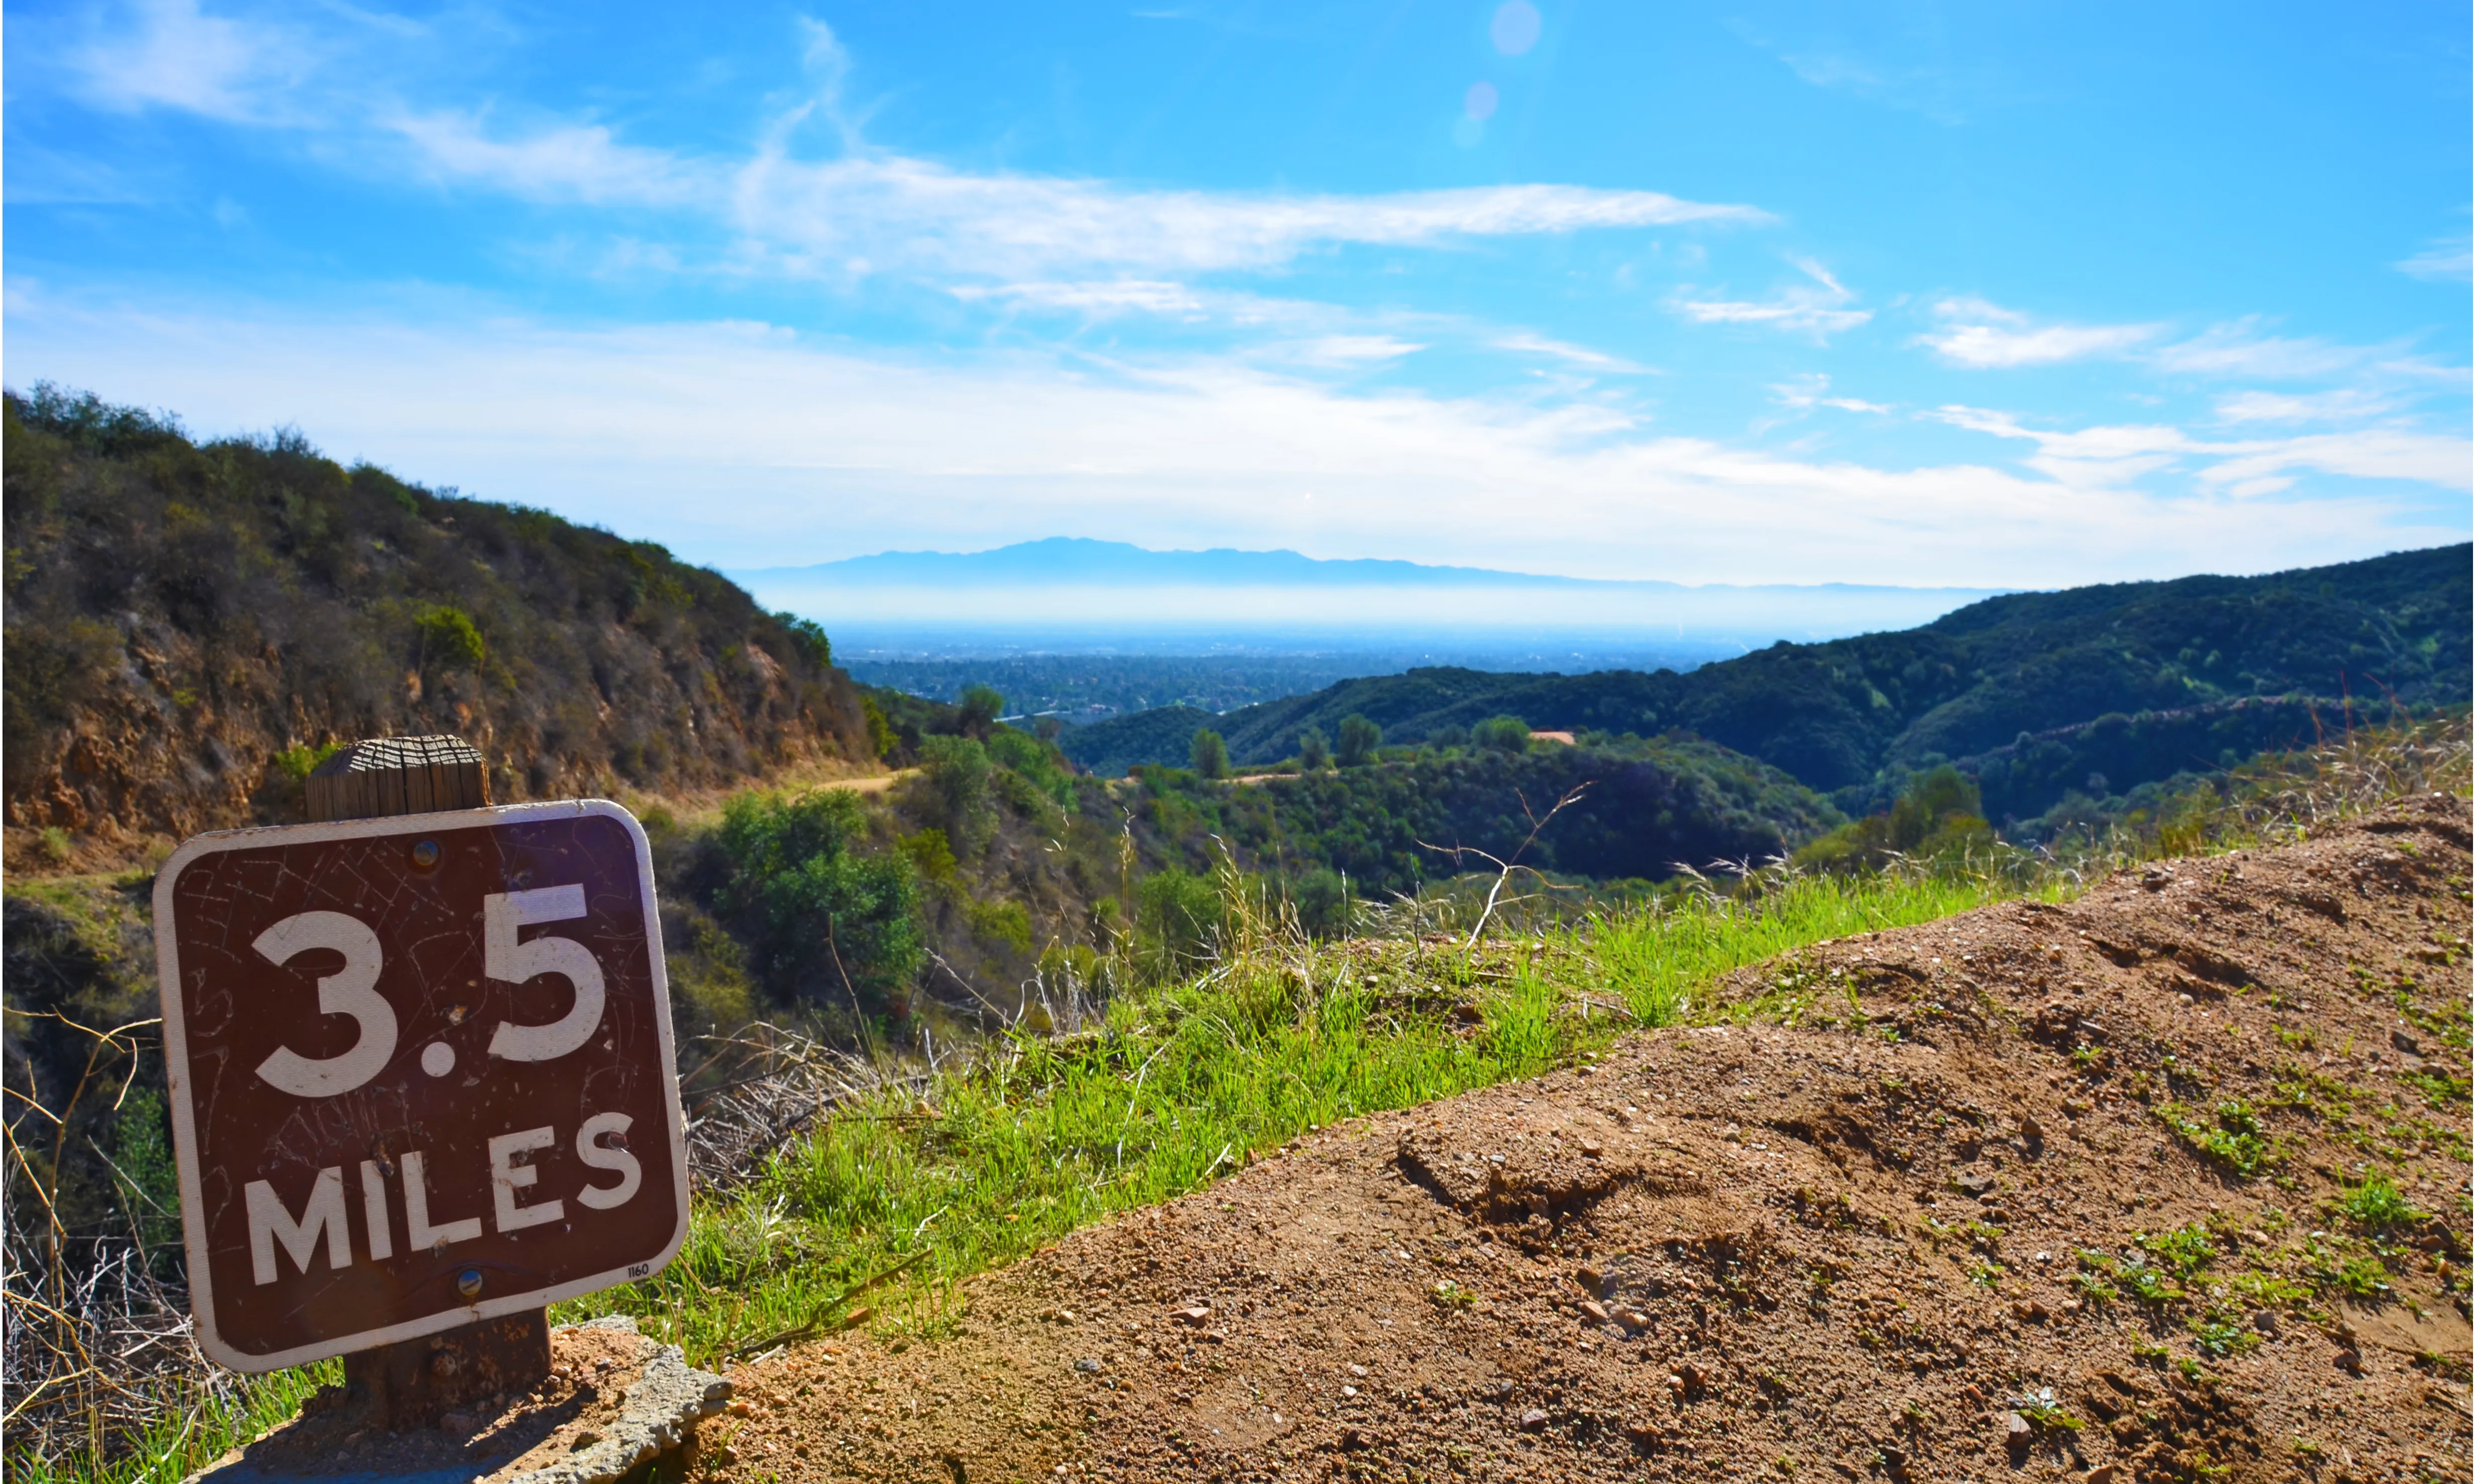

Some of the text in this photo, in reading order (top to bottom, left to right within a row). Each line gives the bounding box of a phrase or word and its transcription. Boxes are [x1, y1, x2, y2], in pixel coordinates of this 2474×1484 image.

[251, 883, 606, 1098] 3.5
[244, 1112, 642, 1286] MILES
[628, 1263, 649, 1278] 1160
